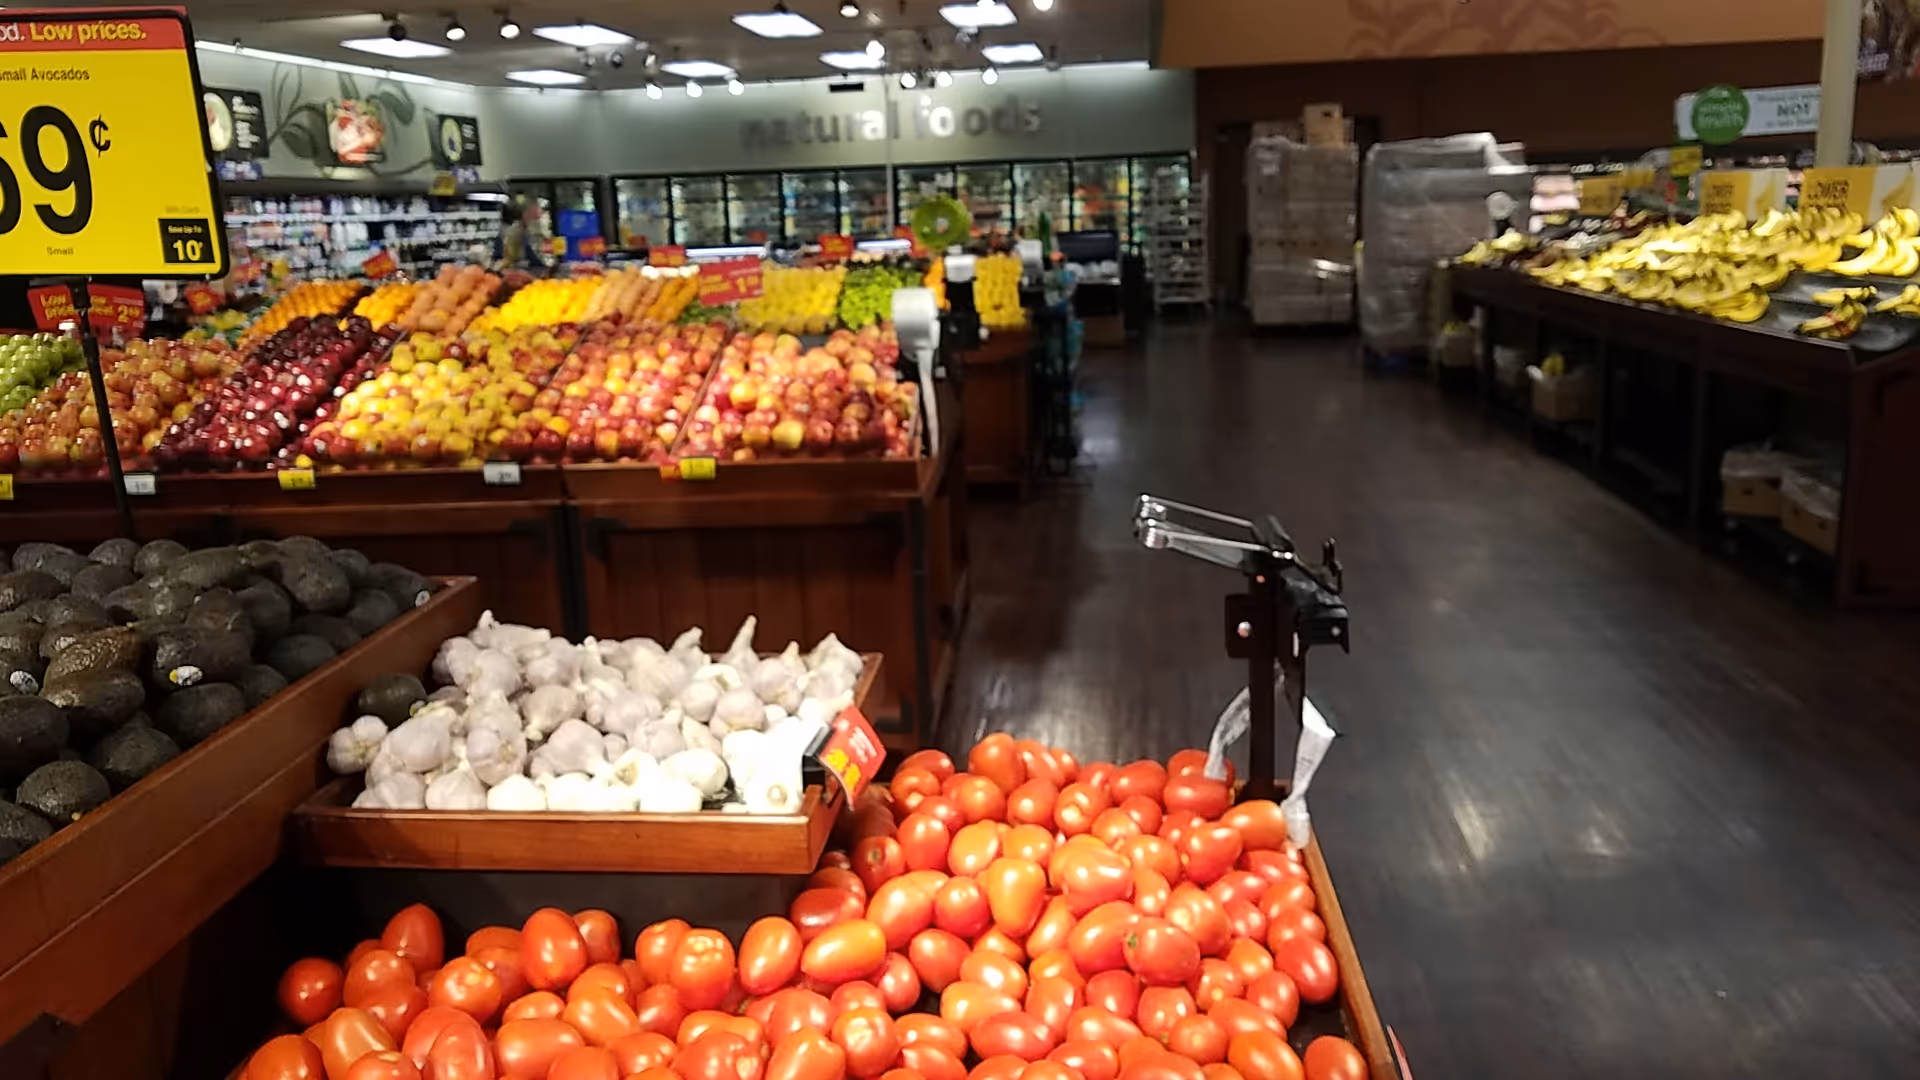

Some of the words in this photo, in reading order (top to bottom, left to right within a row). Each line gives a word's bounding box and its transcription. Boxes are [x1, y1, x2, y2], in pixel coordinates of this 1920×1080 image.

[30, 22, 73, 40] Low
[77, 20, 147, 45] prices.
[0, 67, 27, 81] mall
[31, 67, 90, 81] Avocados
[740, 100, 898, 146] natural
[47, 246, 75, 256] Small
